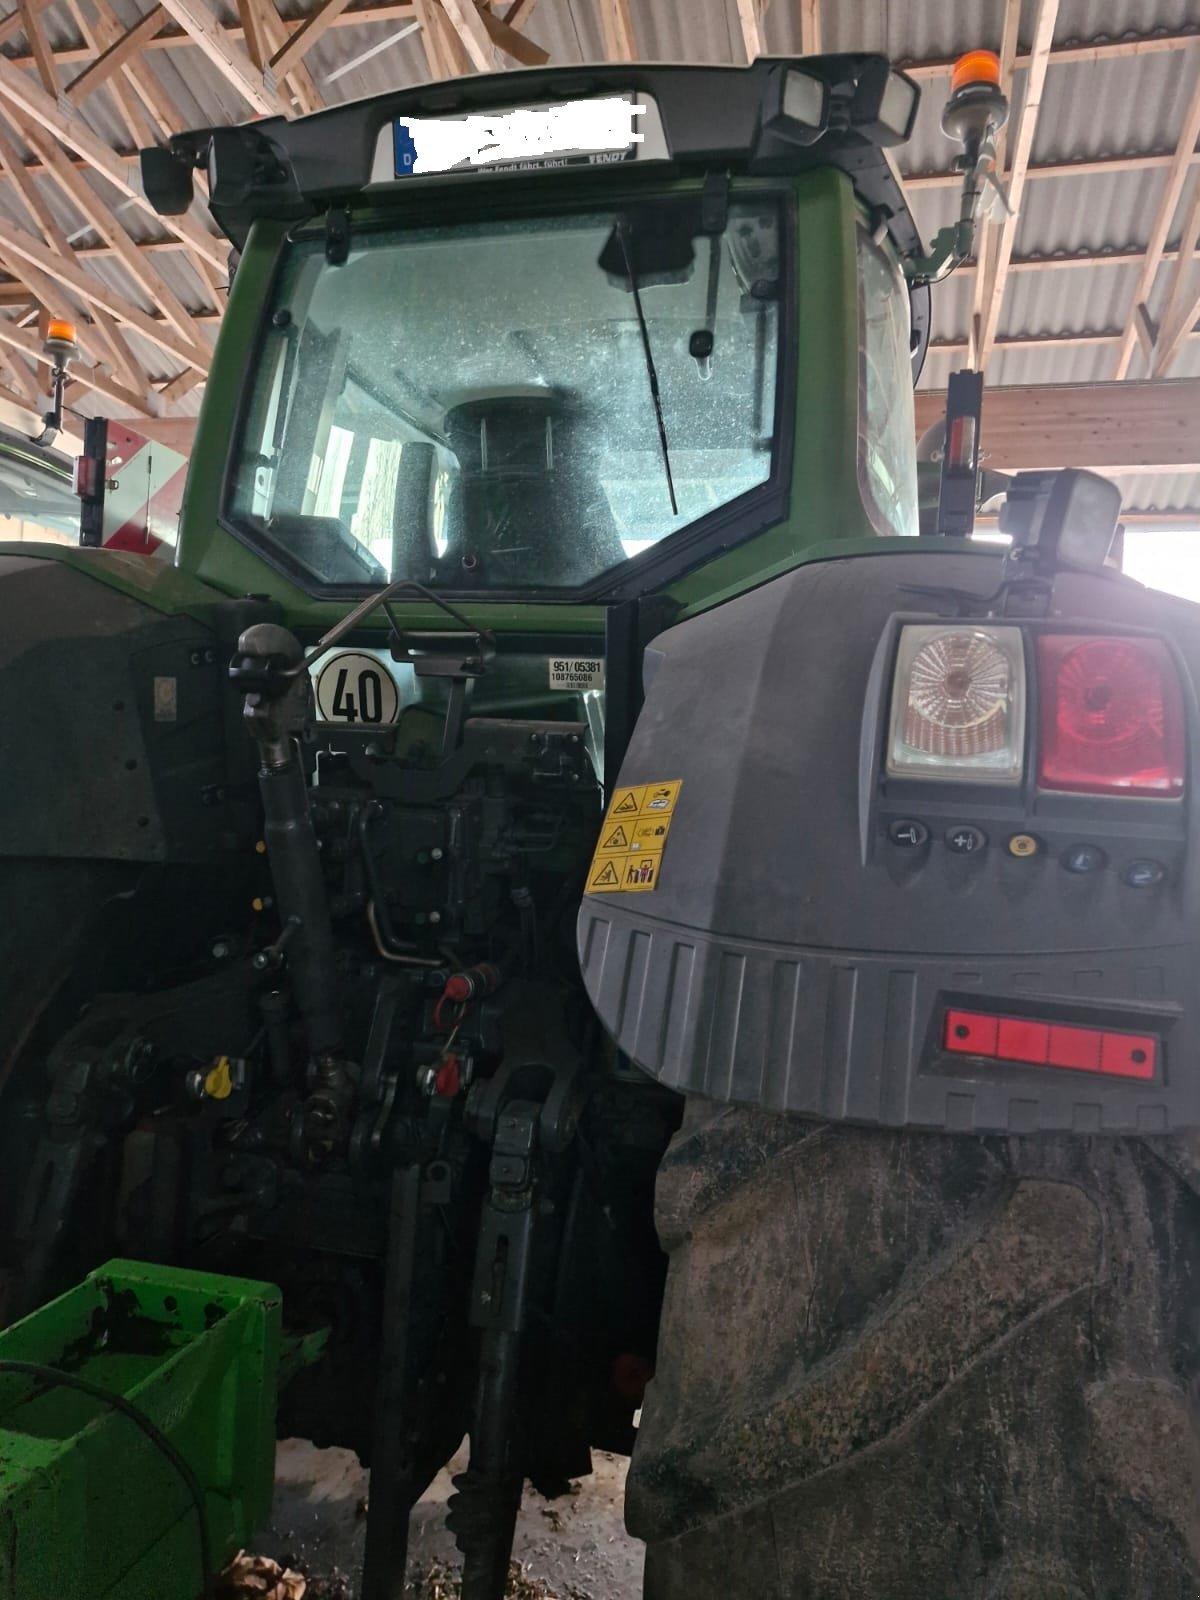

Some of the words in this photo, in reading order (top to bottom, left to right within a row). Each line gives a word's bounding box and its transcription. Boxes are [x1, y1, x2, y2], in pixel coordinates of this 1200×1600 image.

[403, 153, 412, 166] D
[589, 151, 627, 164] FENDT
[333, 668, 382, 722] 40
